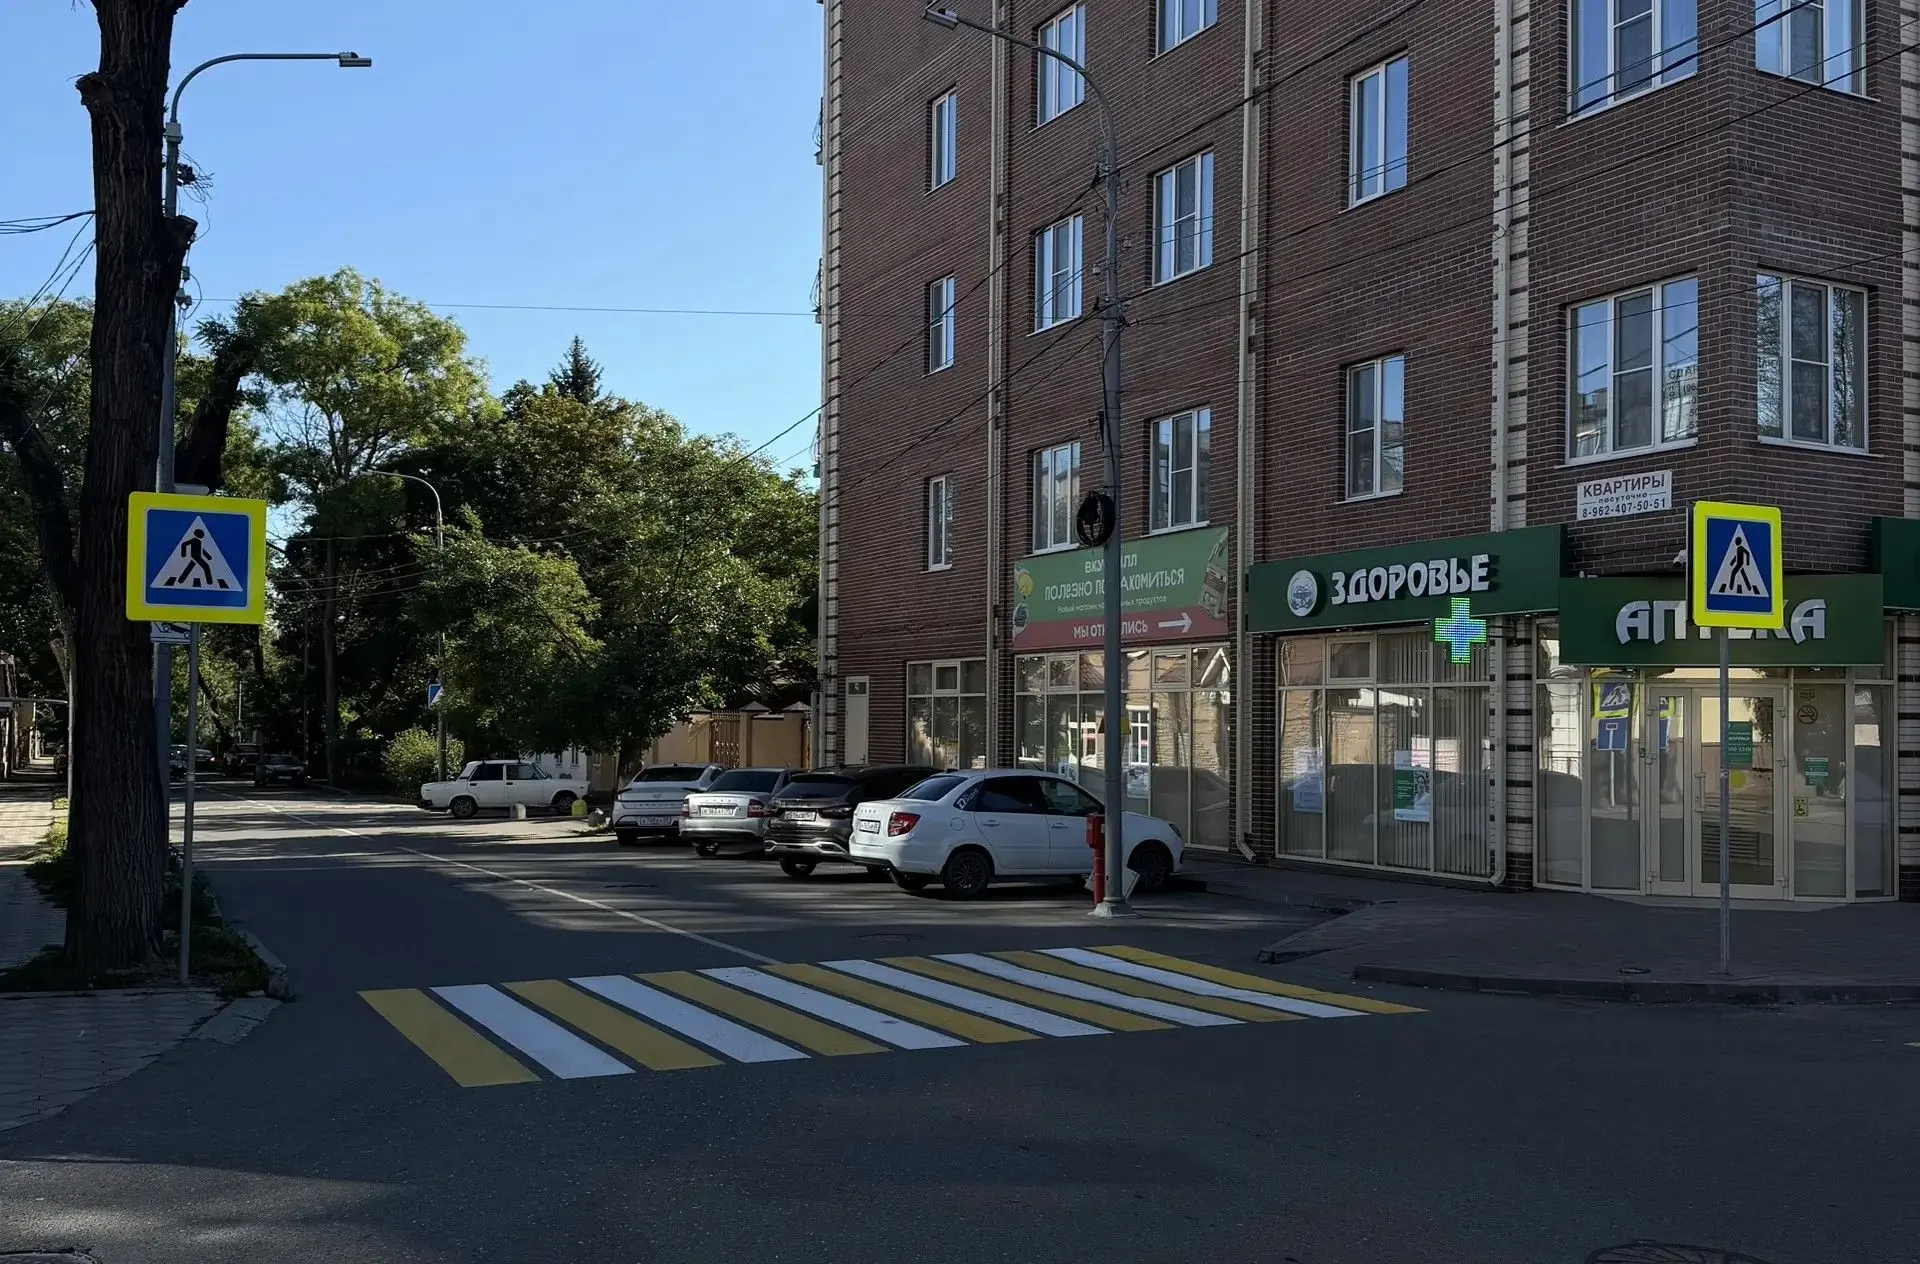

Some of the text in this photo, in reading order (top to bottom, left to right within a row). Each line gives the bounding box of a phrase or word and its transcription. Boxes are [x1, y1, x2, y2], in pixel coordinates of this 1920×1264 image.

[1583, 474, 1665, 498] КВАРТИРЫ
[1582, 498, 1666, 518] 8-962-407-50-51
[1598, 492, 1648, 504] посуточно
[1085, 553, 1138, 574] ВКУЛЛ
[1095, 567, 1185, 595] ПАКОМИТЬСЯ
[1331, 553, 1490, 605] ЗДОРОВЬЕ
[1073, 619, 1148, 638] МЫ ОТЛИСЬ
[1615, 599, 1827, 645] АПА
